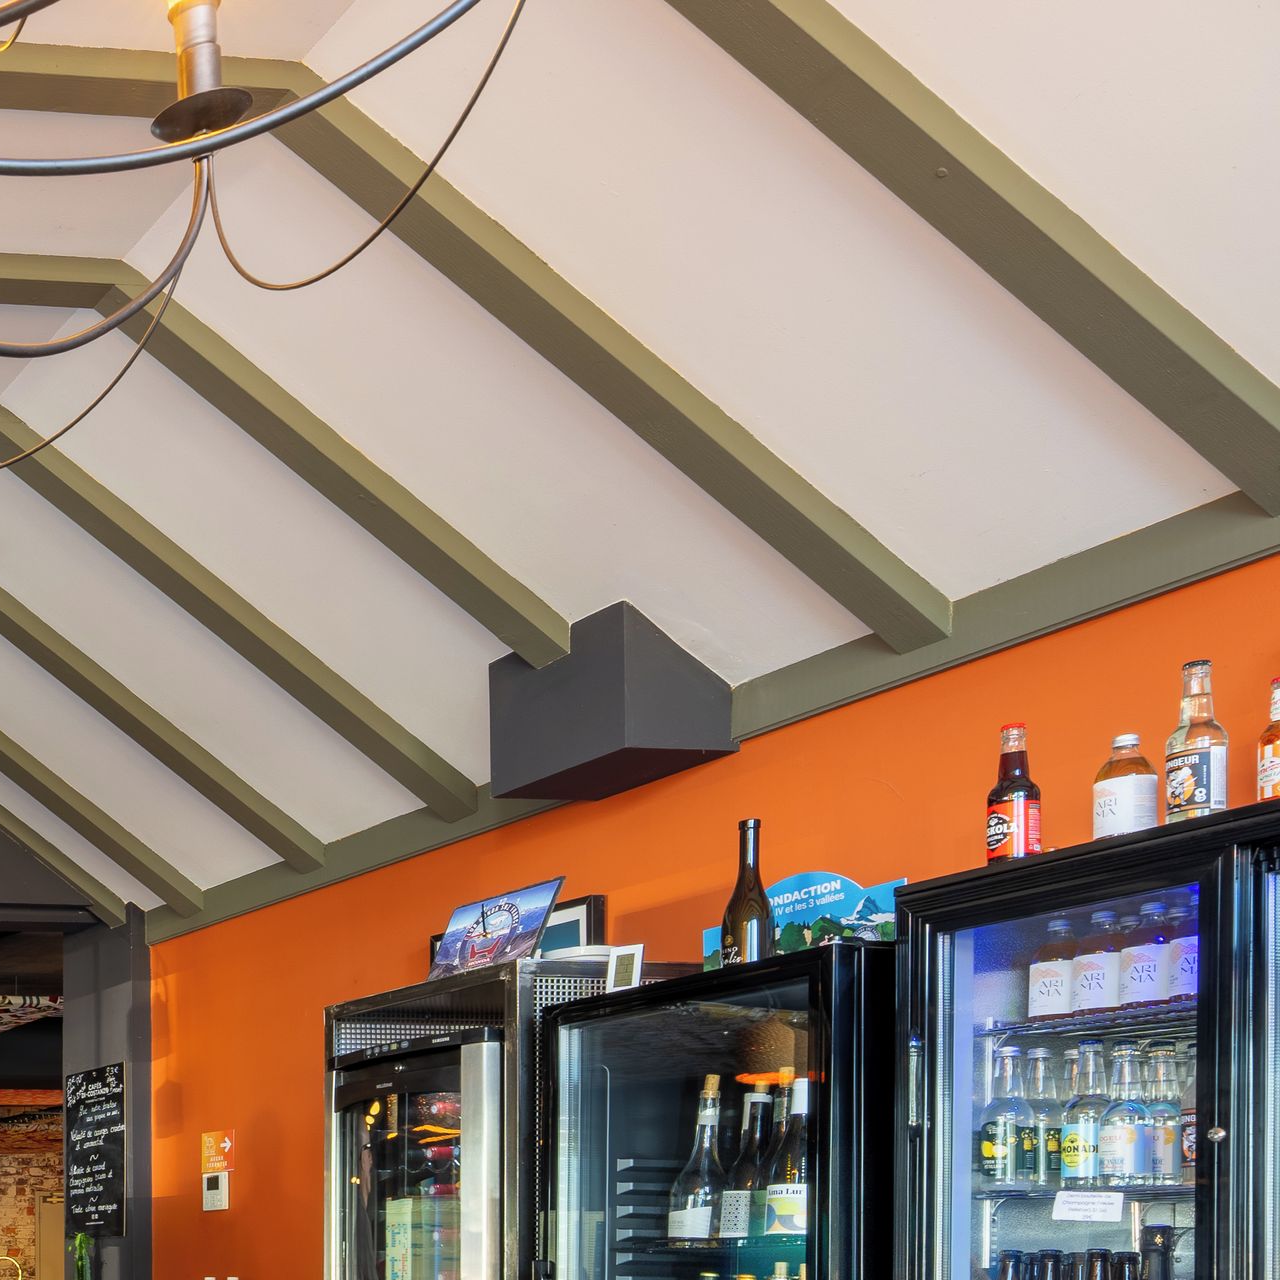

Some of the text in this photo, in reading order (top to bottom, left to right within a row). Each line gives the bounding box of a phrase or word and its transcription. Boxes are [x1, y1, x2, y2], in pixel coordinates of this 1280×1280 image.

[785, 904, 794, 914] et
[795, 902, 807, 912] les
[808, 899, 815, 908] 3
[815, 892, 845, 906] vallées
[1132, 963, 1157, 974] ARI
[1083, 972, 1105, 982] ARI
